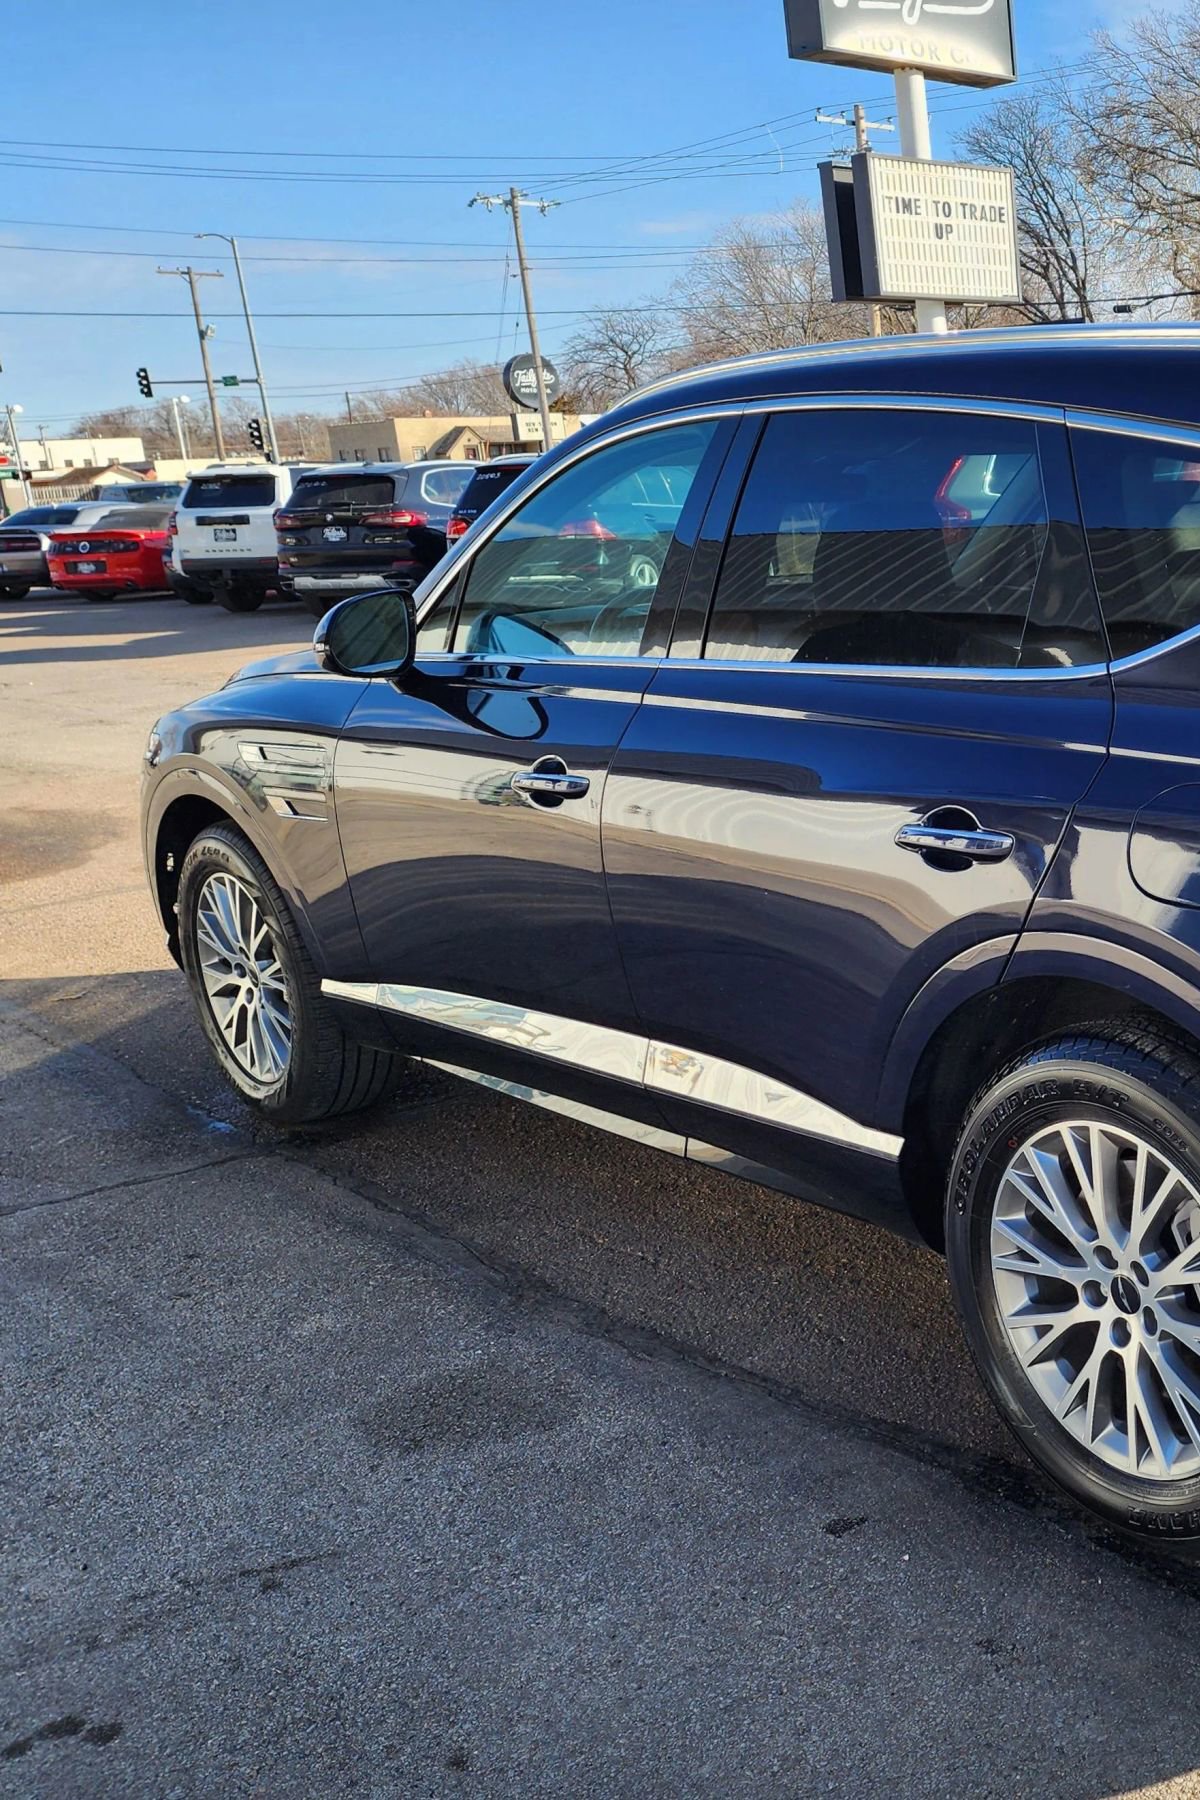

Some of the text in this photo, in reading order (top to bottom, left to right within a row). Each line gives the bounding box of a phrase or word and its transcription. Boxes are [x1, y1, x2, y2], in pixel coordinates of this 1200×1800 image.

[859, 33, 941, 62] MOTOR
[884, 195, 1006, 223] TIME TO TRADE
[934, 222, 953, 241] UP
